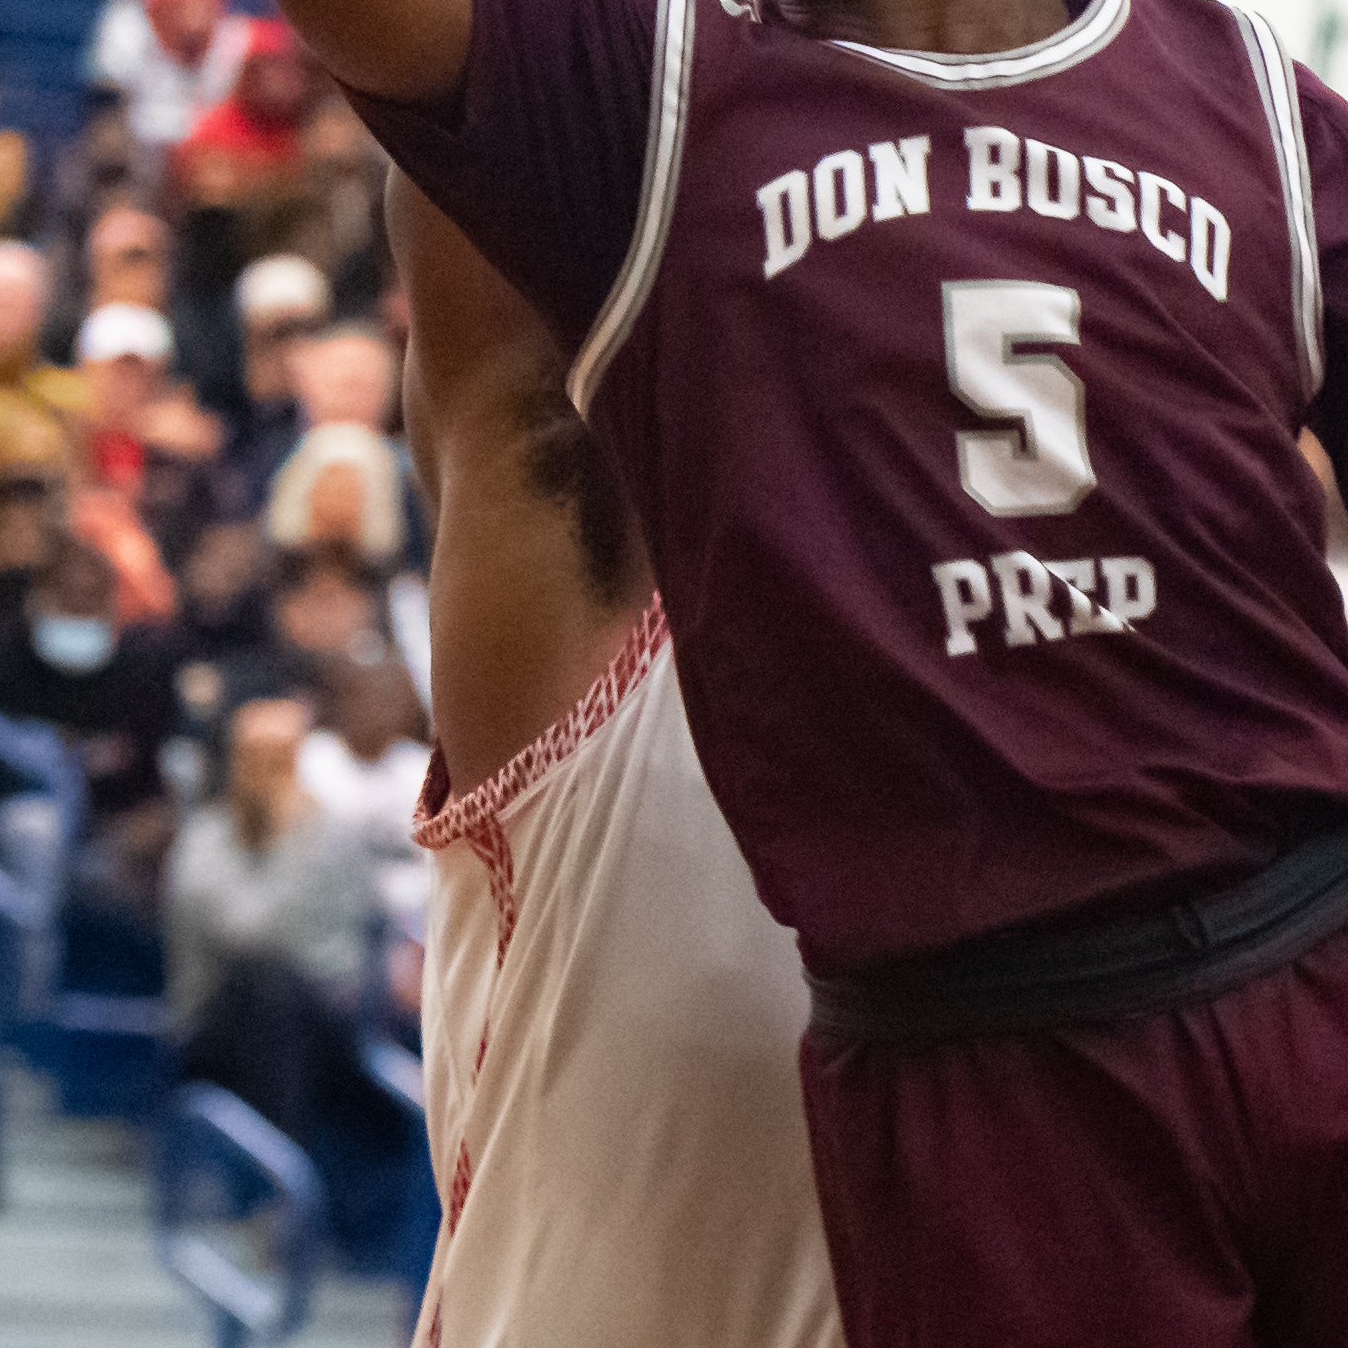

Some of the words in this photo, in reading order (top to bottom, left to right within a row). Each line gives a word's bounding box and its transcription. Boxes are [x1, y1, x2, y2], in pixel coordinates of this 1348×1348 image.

[756, 135, 931, 281] DON
[963, 126, 1231, 302] BOSCO
[942, 279, 1097, 517] 5
[931, 549, 1157, 657] PREP
